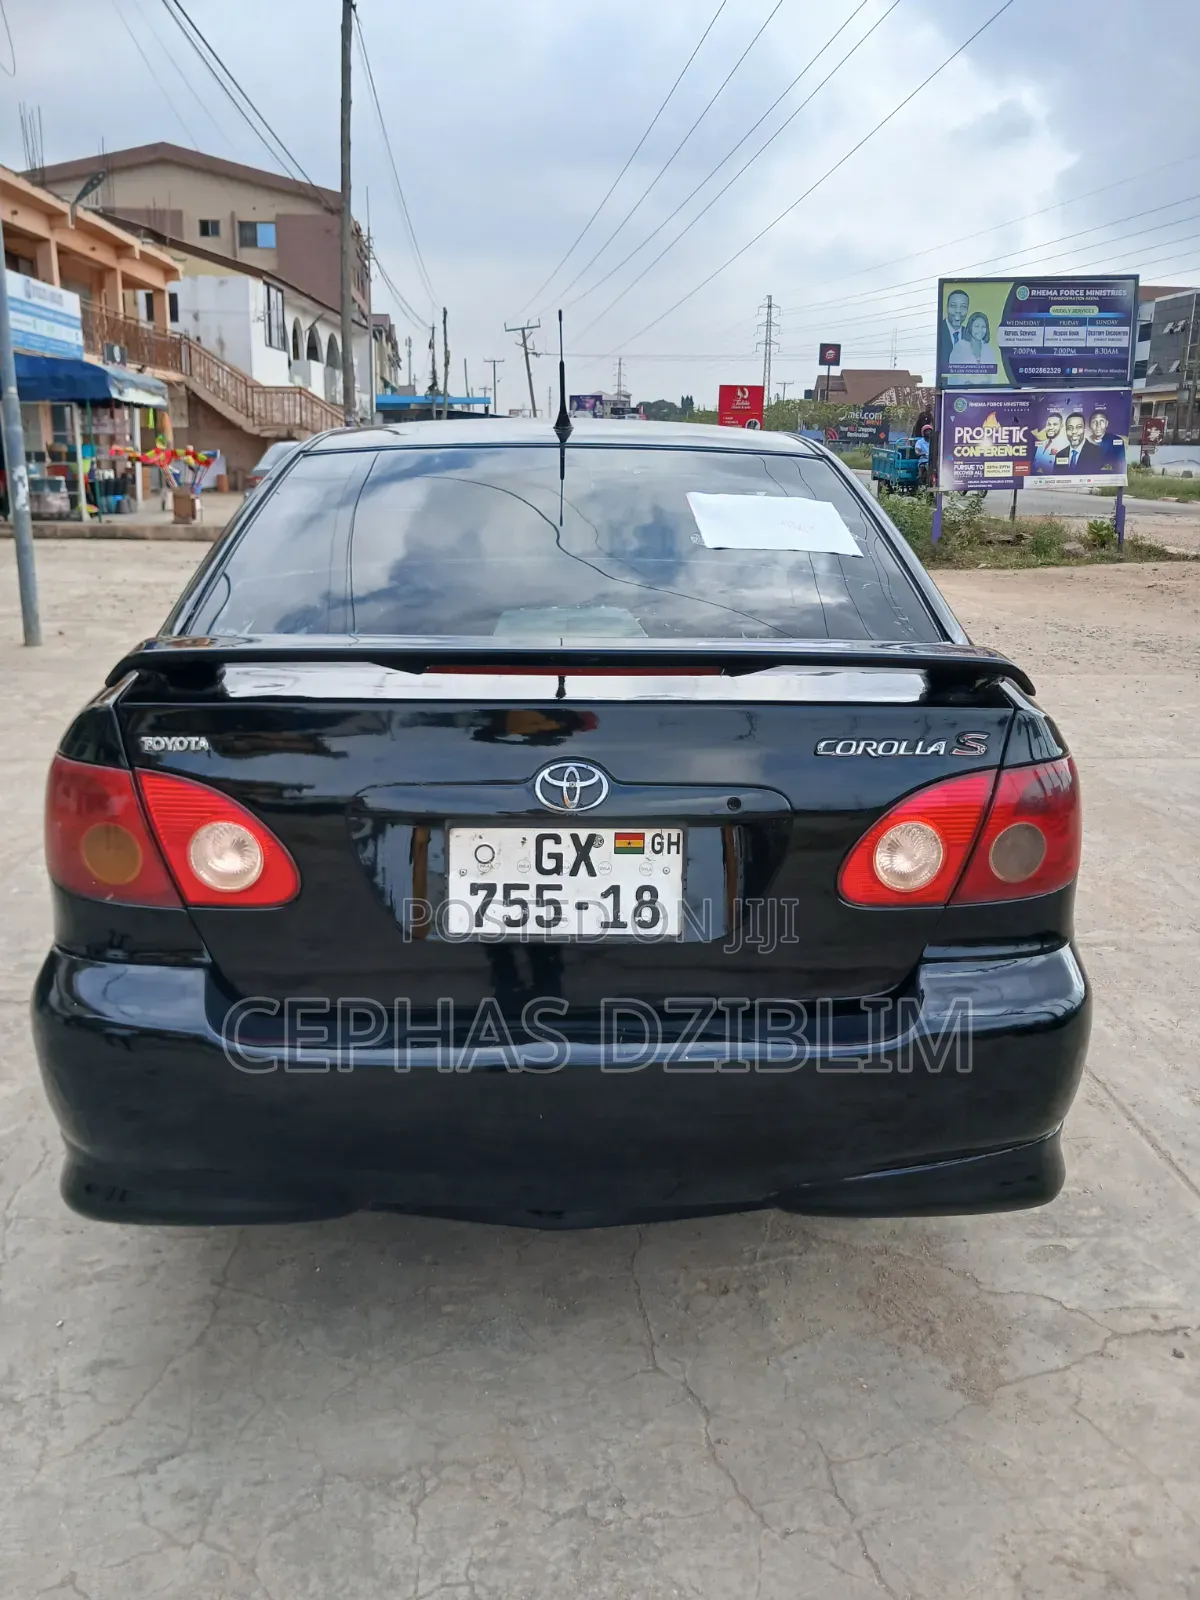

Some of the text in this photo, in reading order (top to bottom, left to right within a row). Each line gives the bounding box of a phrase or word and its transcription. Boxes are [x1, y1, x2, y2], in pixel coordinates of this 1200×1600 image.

[954, 426, 1028, 443] PROPHETIC
[953, 445, 1028, 457] CONFERENCE
[140, 736, 209, 751] TOYOTA
[815, 731, 990, 757] COROLLA S
[651, 833, 681, 854] GH
[535, 833, 598, 877] GX
[470, 883, 661, 929] 755-18
